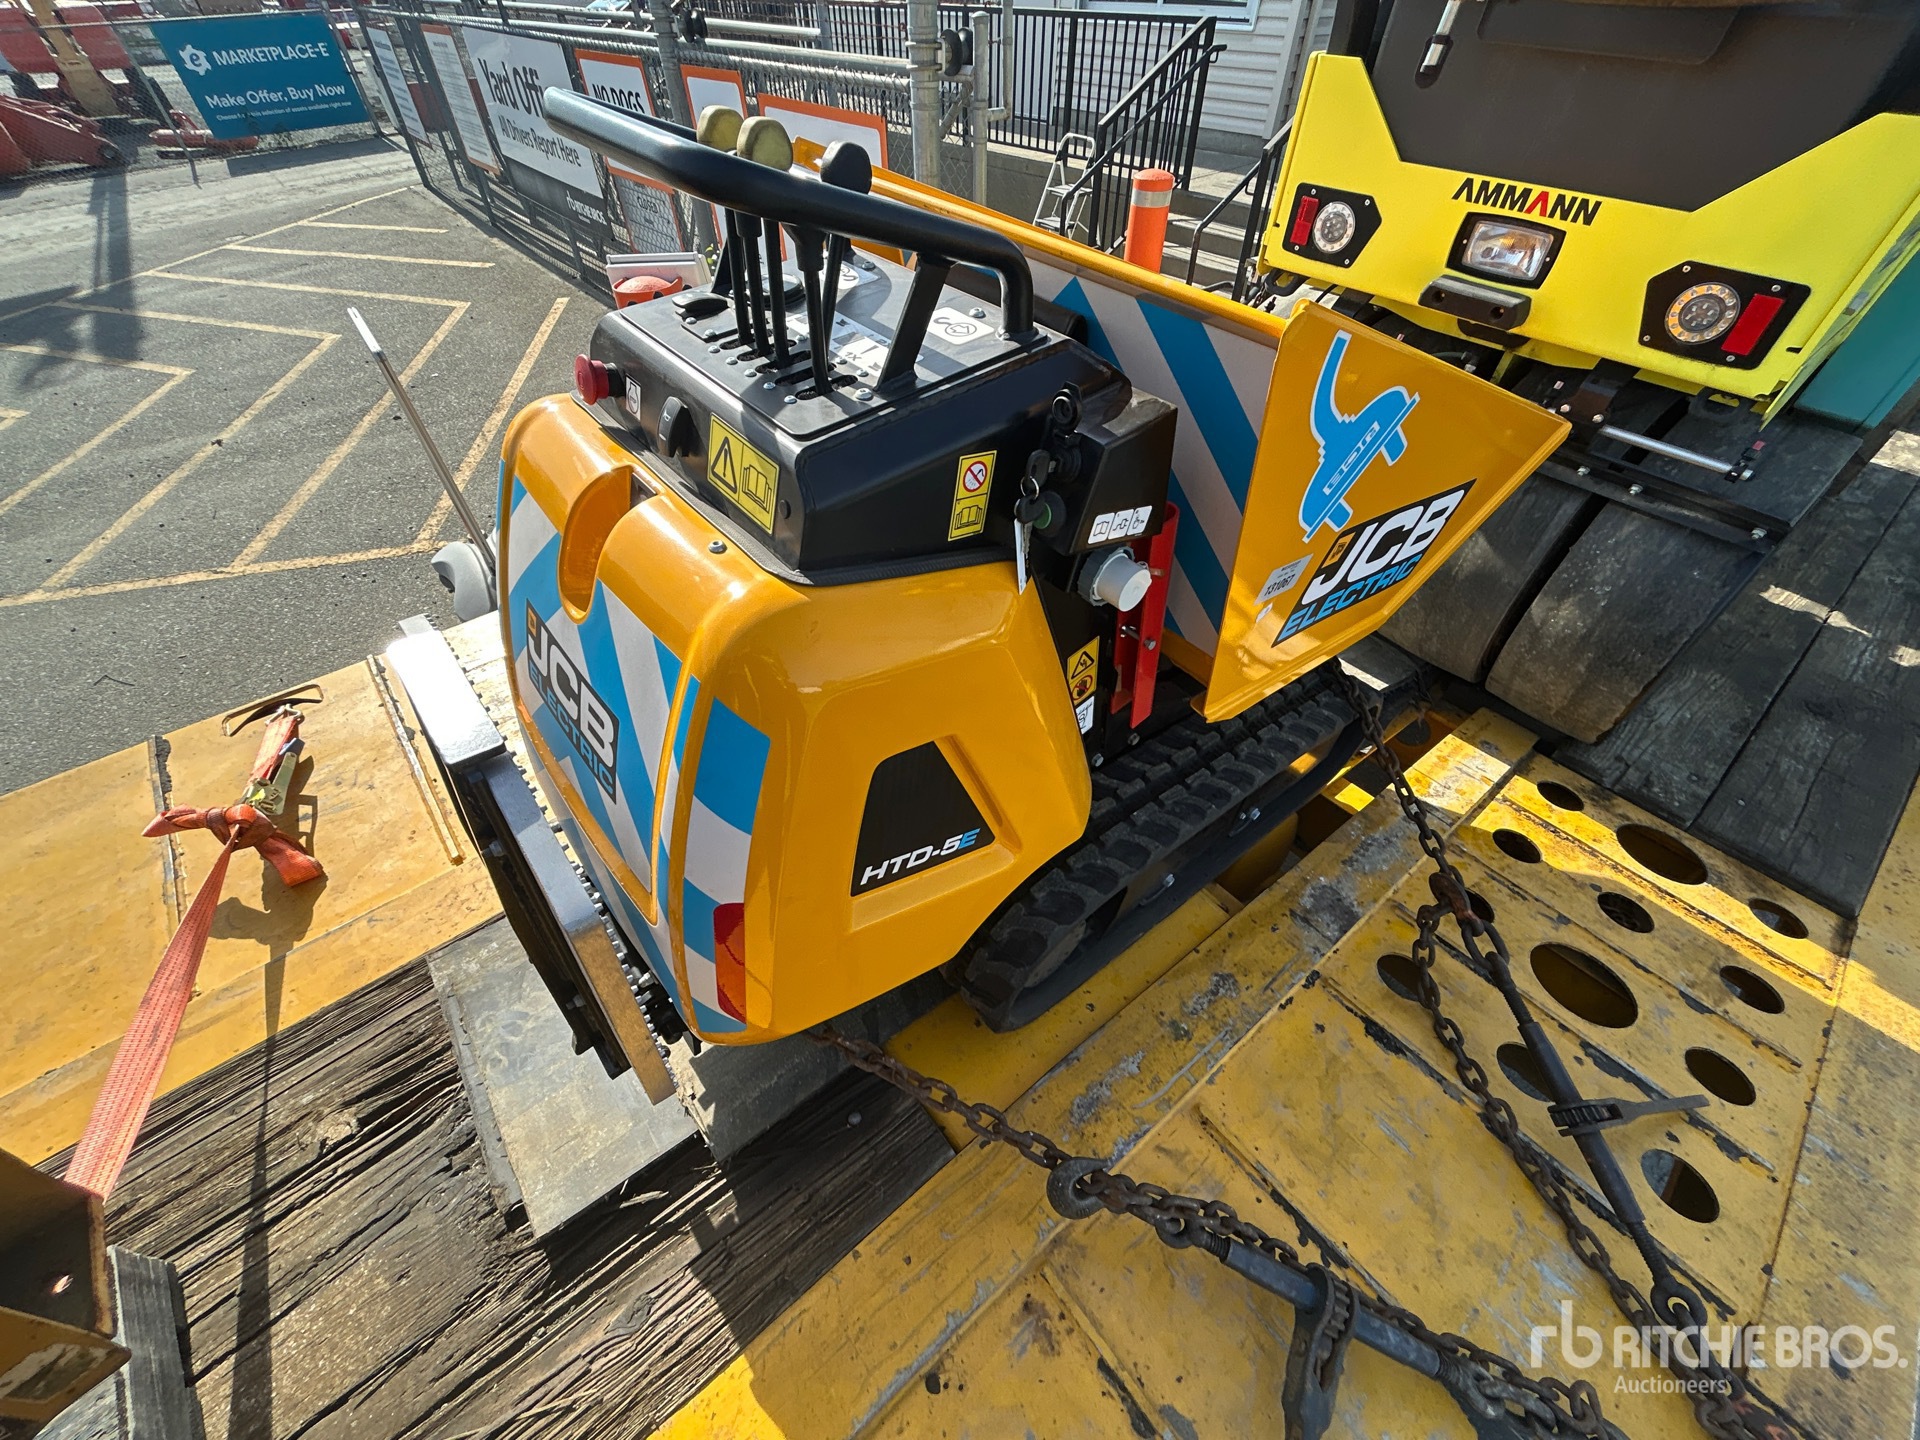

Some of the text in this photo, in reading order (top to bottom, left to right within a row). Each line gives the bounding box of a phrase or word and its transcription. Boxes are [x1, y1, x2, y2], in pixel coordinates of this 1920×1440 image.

[212, 43, 329, 66] MARKETPLACE-E
[204, 84, 346, 108] Make Offer, Buy Now
[477, 58, 519, 111] Yard
[592, 83, 645, 114] NO DOGS
[498, 114, 581, 167] All Drivers Report Here
[1451, 177, 1602, 226] AMMANN
[1301, 489, 1465, 605] JCB
[1276, 553, 1422, 642] ELECTRIC
[528, 625, 614, 768] JCB
[529, 659, 614, 795] ELECTRIC
[860, 828, 980, 886] HTD-5E
